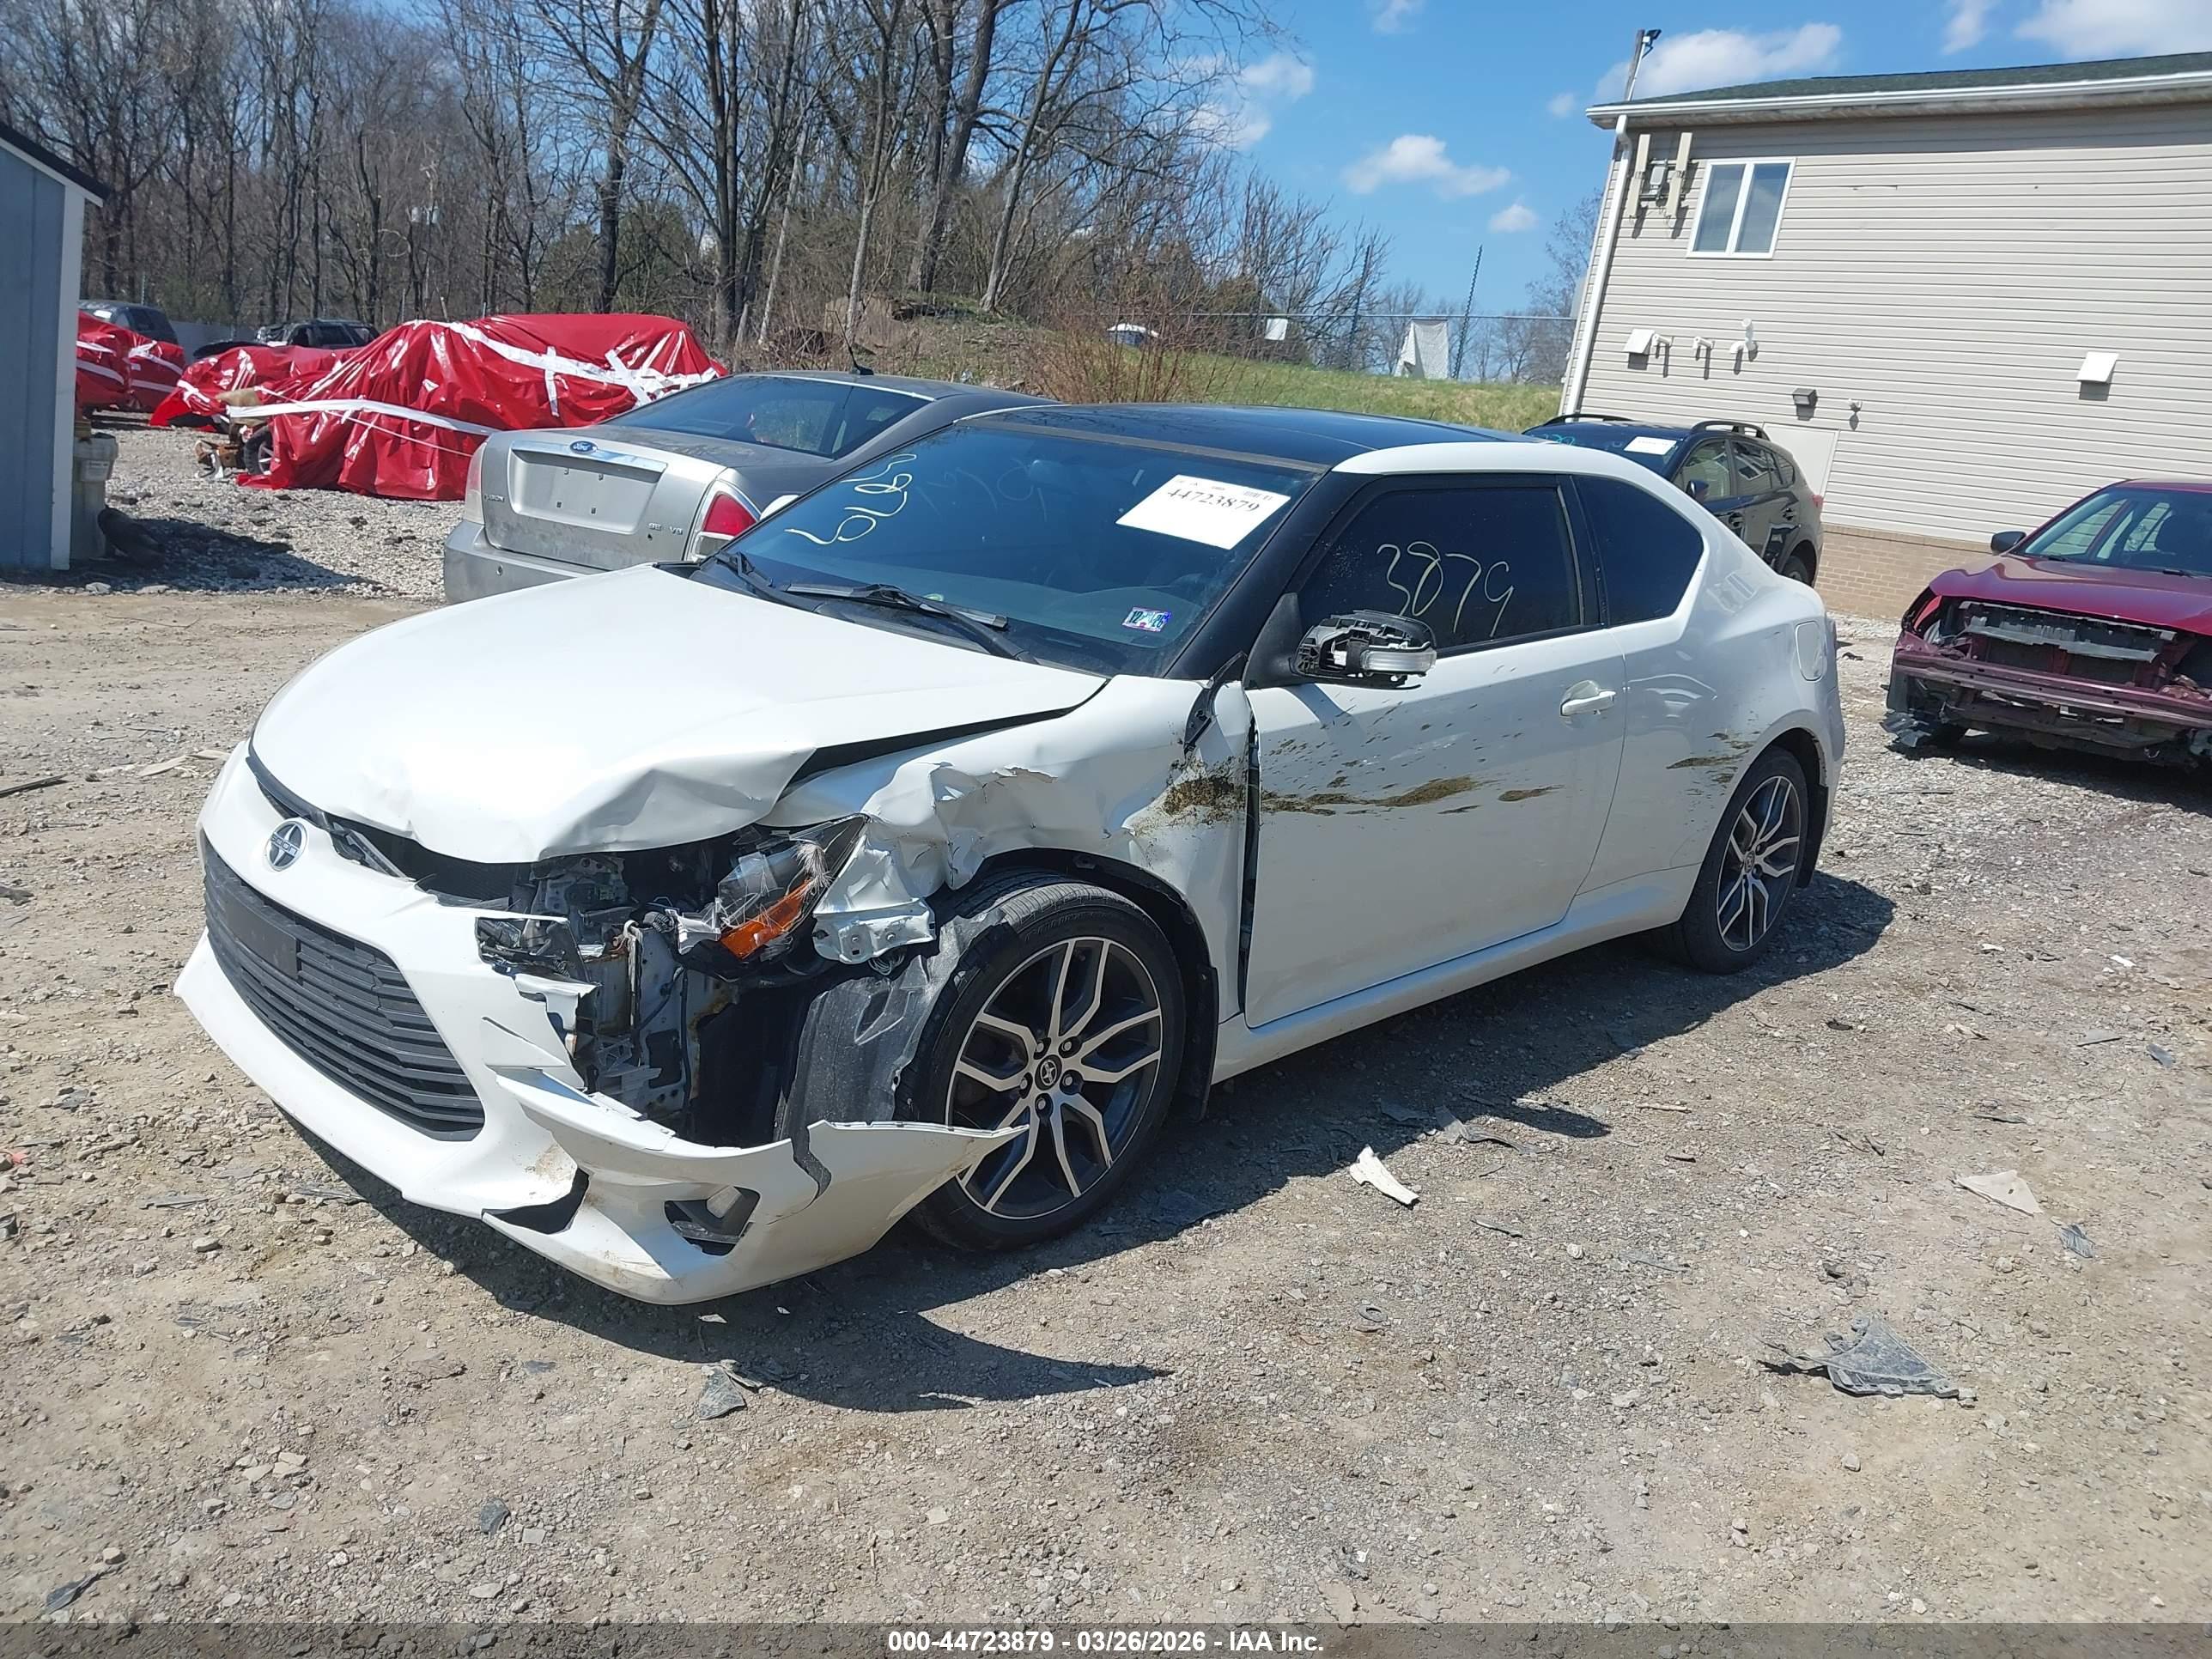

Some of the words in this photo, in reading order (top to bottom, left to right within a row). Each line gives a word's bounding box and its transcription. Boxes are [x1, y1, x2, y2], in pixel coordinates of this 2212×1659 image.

[572, 441, 592, 452] Ford
[1167, 488, 1260, 512] 44723879
[1376, 541, 1513, 637] 3879
